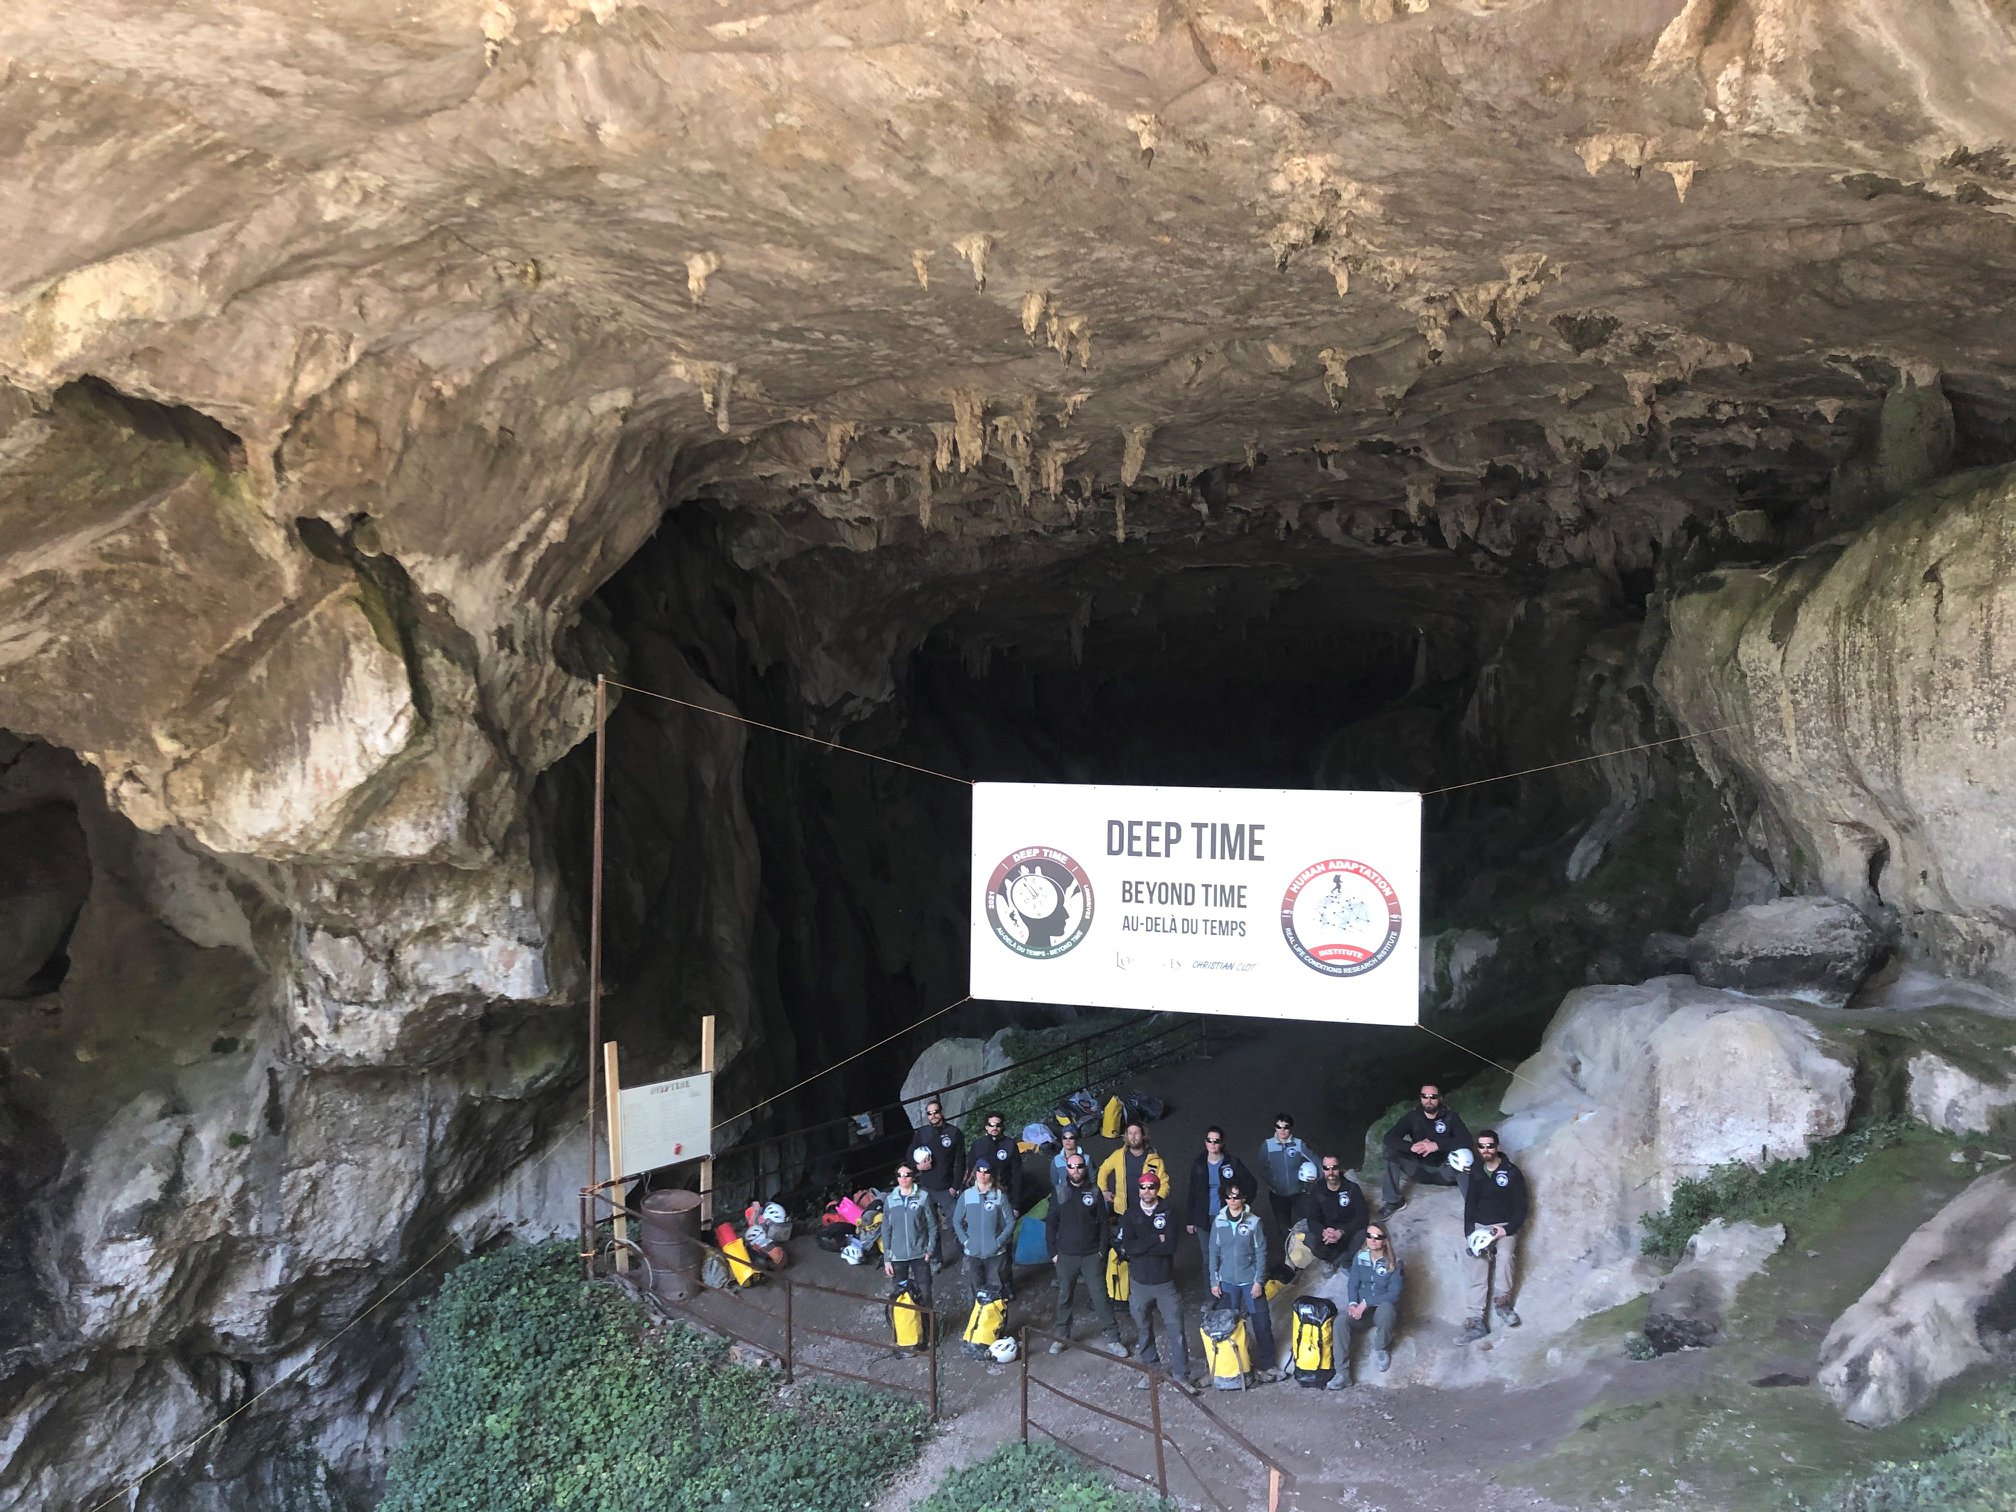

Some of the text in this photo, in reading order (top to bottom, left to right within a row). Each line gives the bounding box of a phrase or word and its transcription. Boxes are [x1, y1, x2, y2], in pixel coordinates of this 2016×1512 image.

[1107, 819, 1266, 862] DEEP TIME
[1012, 848, 1069, 864] DEEP TIME
[1290, 861, 1393, 896] HUMAN ADAPTATION
[1121, 881, 1248, 909] BEYOND TIME
[1122, 914, 1246, 938] AU-DELÀ DU TEMPS
[1016, 945, 1026, 953] DU
[1026, 948, 1046, 957] TEMPS
[1049, 941, 1072, 956] BEYOND
[1071, 930, 1083, 944] TIME
[1284, 927, 1398, 974] REAL LIFE CONDITIONS RESEARCH INSTITUTE
[1319, 948, 1363, 959] INSTITUTE
[1192, 961, 1234, 971] CHRISTIAN
